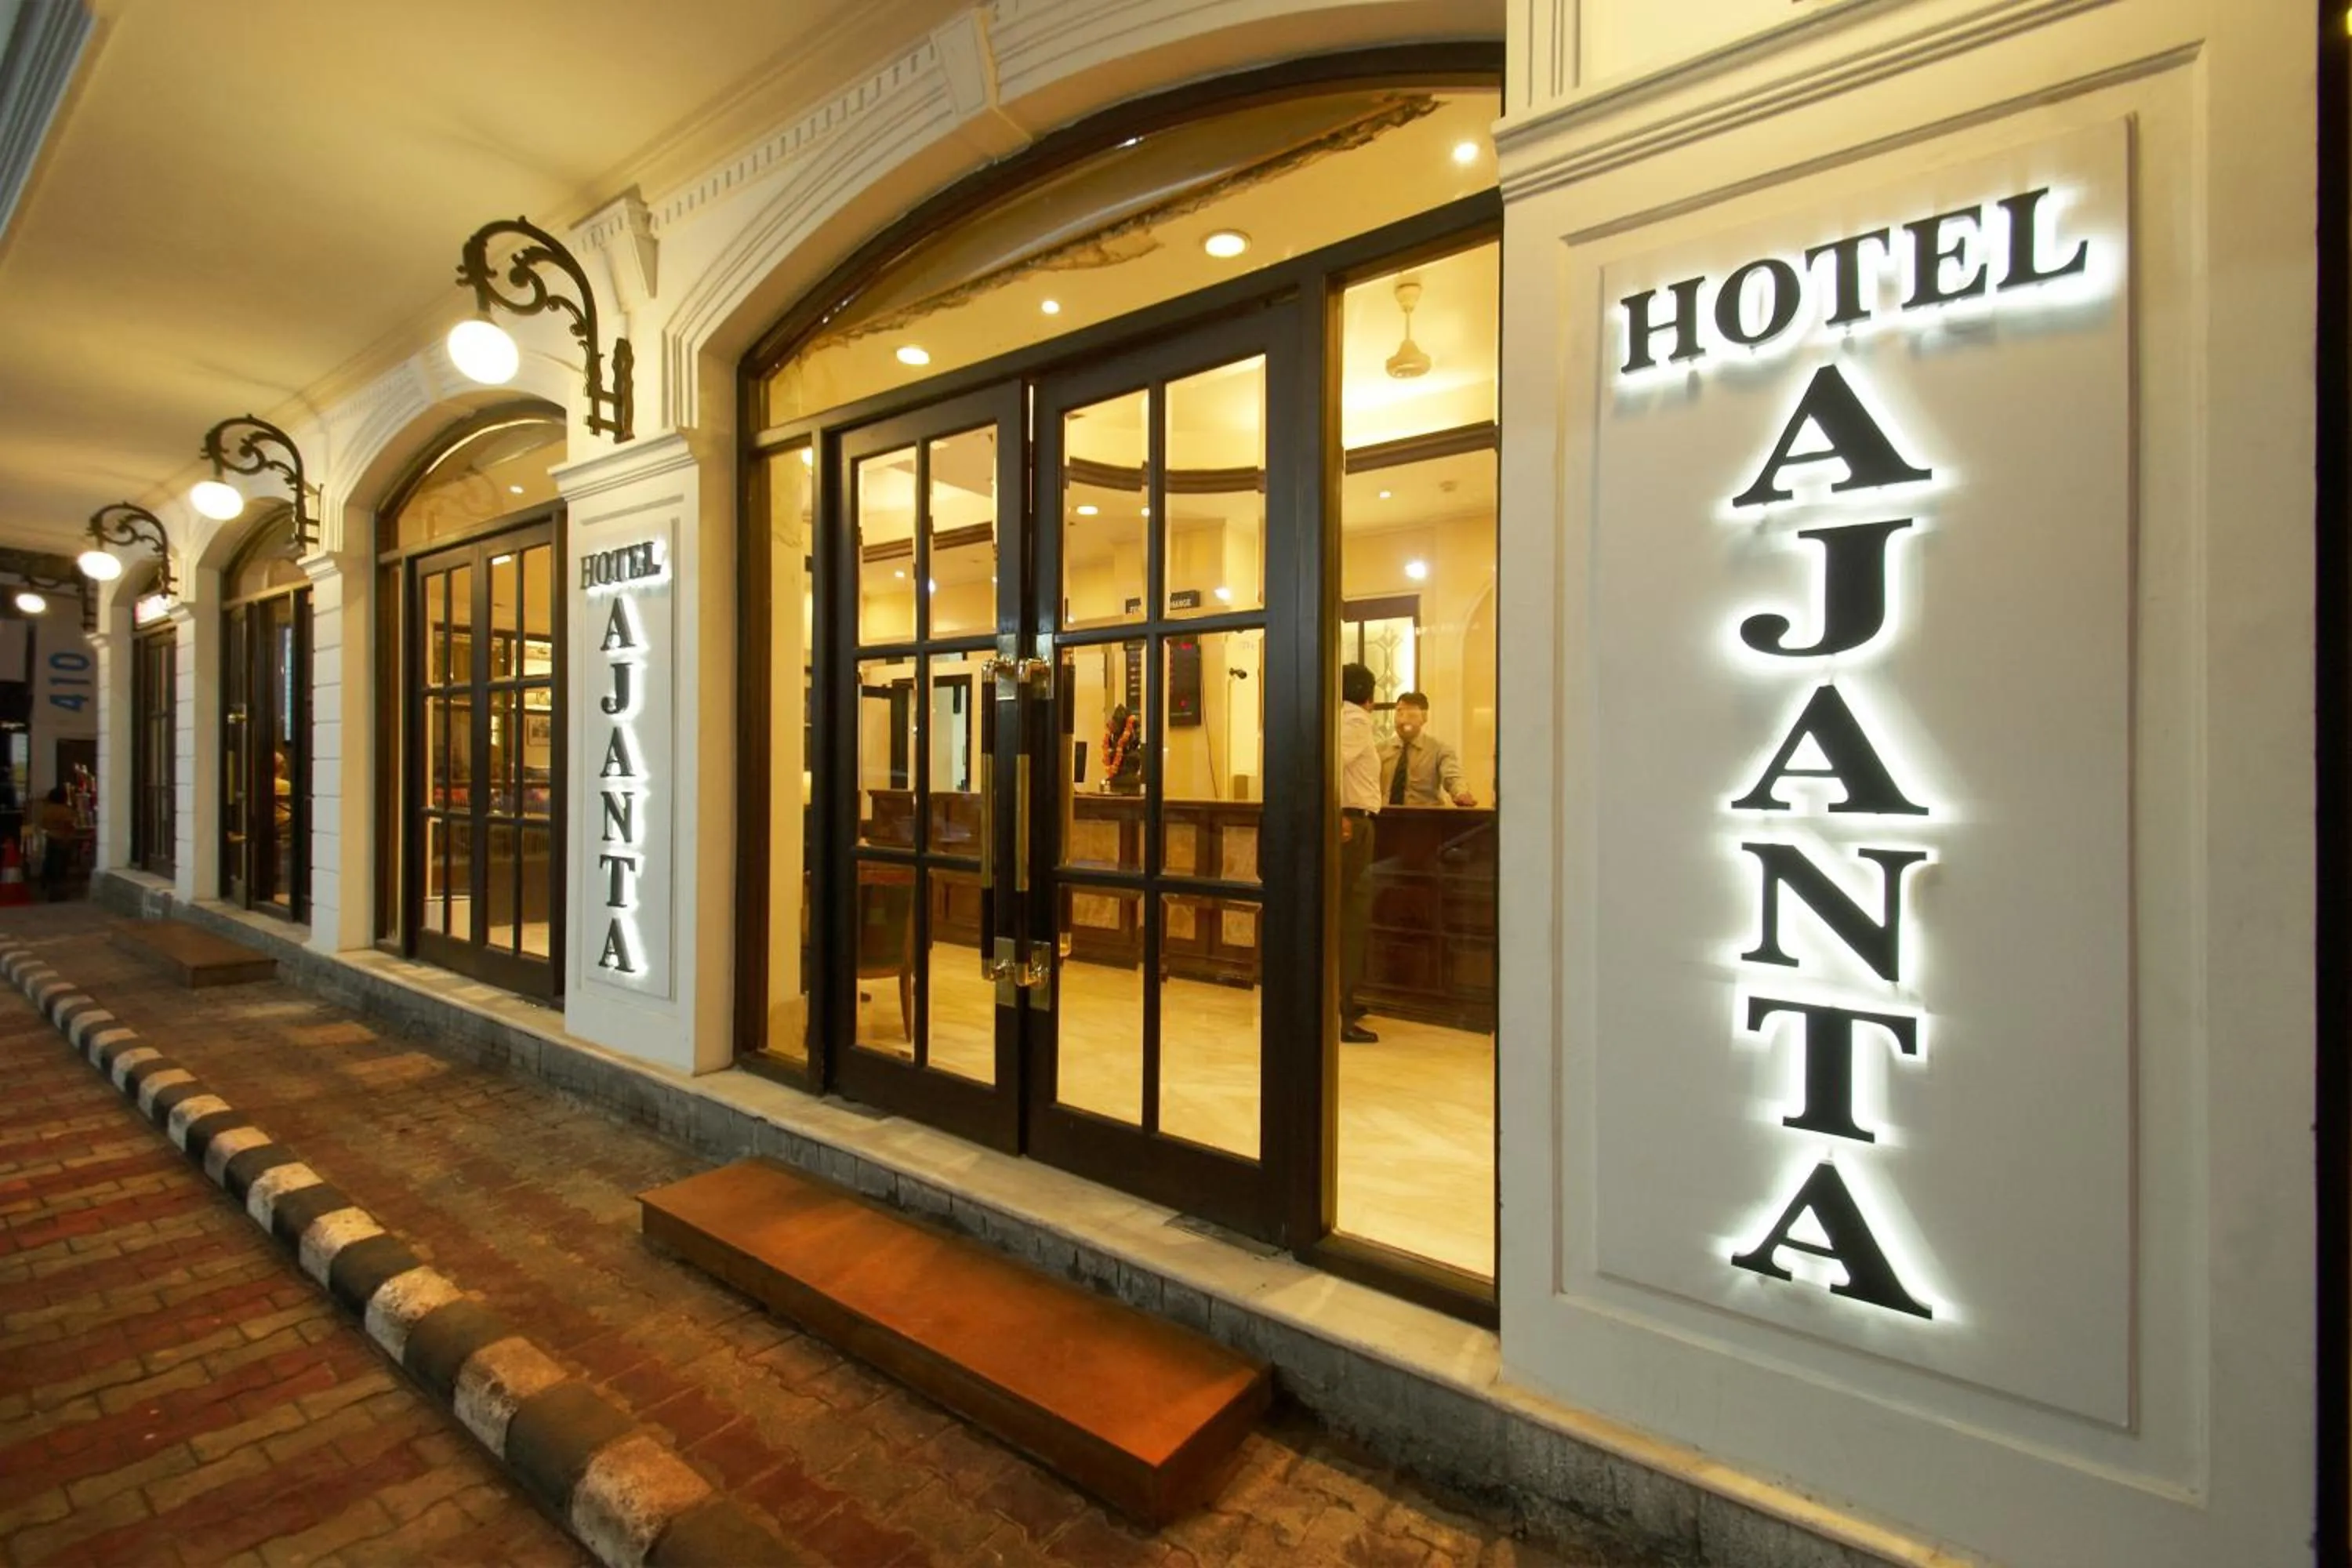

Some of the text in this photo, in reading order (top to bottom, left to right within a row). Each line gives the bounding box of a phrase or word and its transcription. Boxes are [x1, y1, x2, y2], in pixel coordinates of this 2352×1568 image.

[1621, 187, 2089, 375] HOTEL
[579, 541, 662, 590] HOTEL
[49, 653, 90, 713] 410
[600, 597, 637, 972] AJANTA
[1731, 364, 1933, 1319] AJANTA
